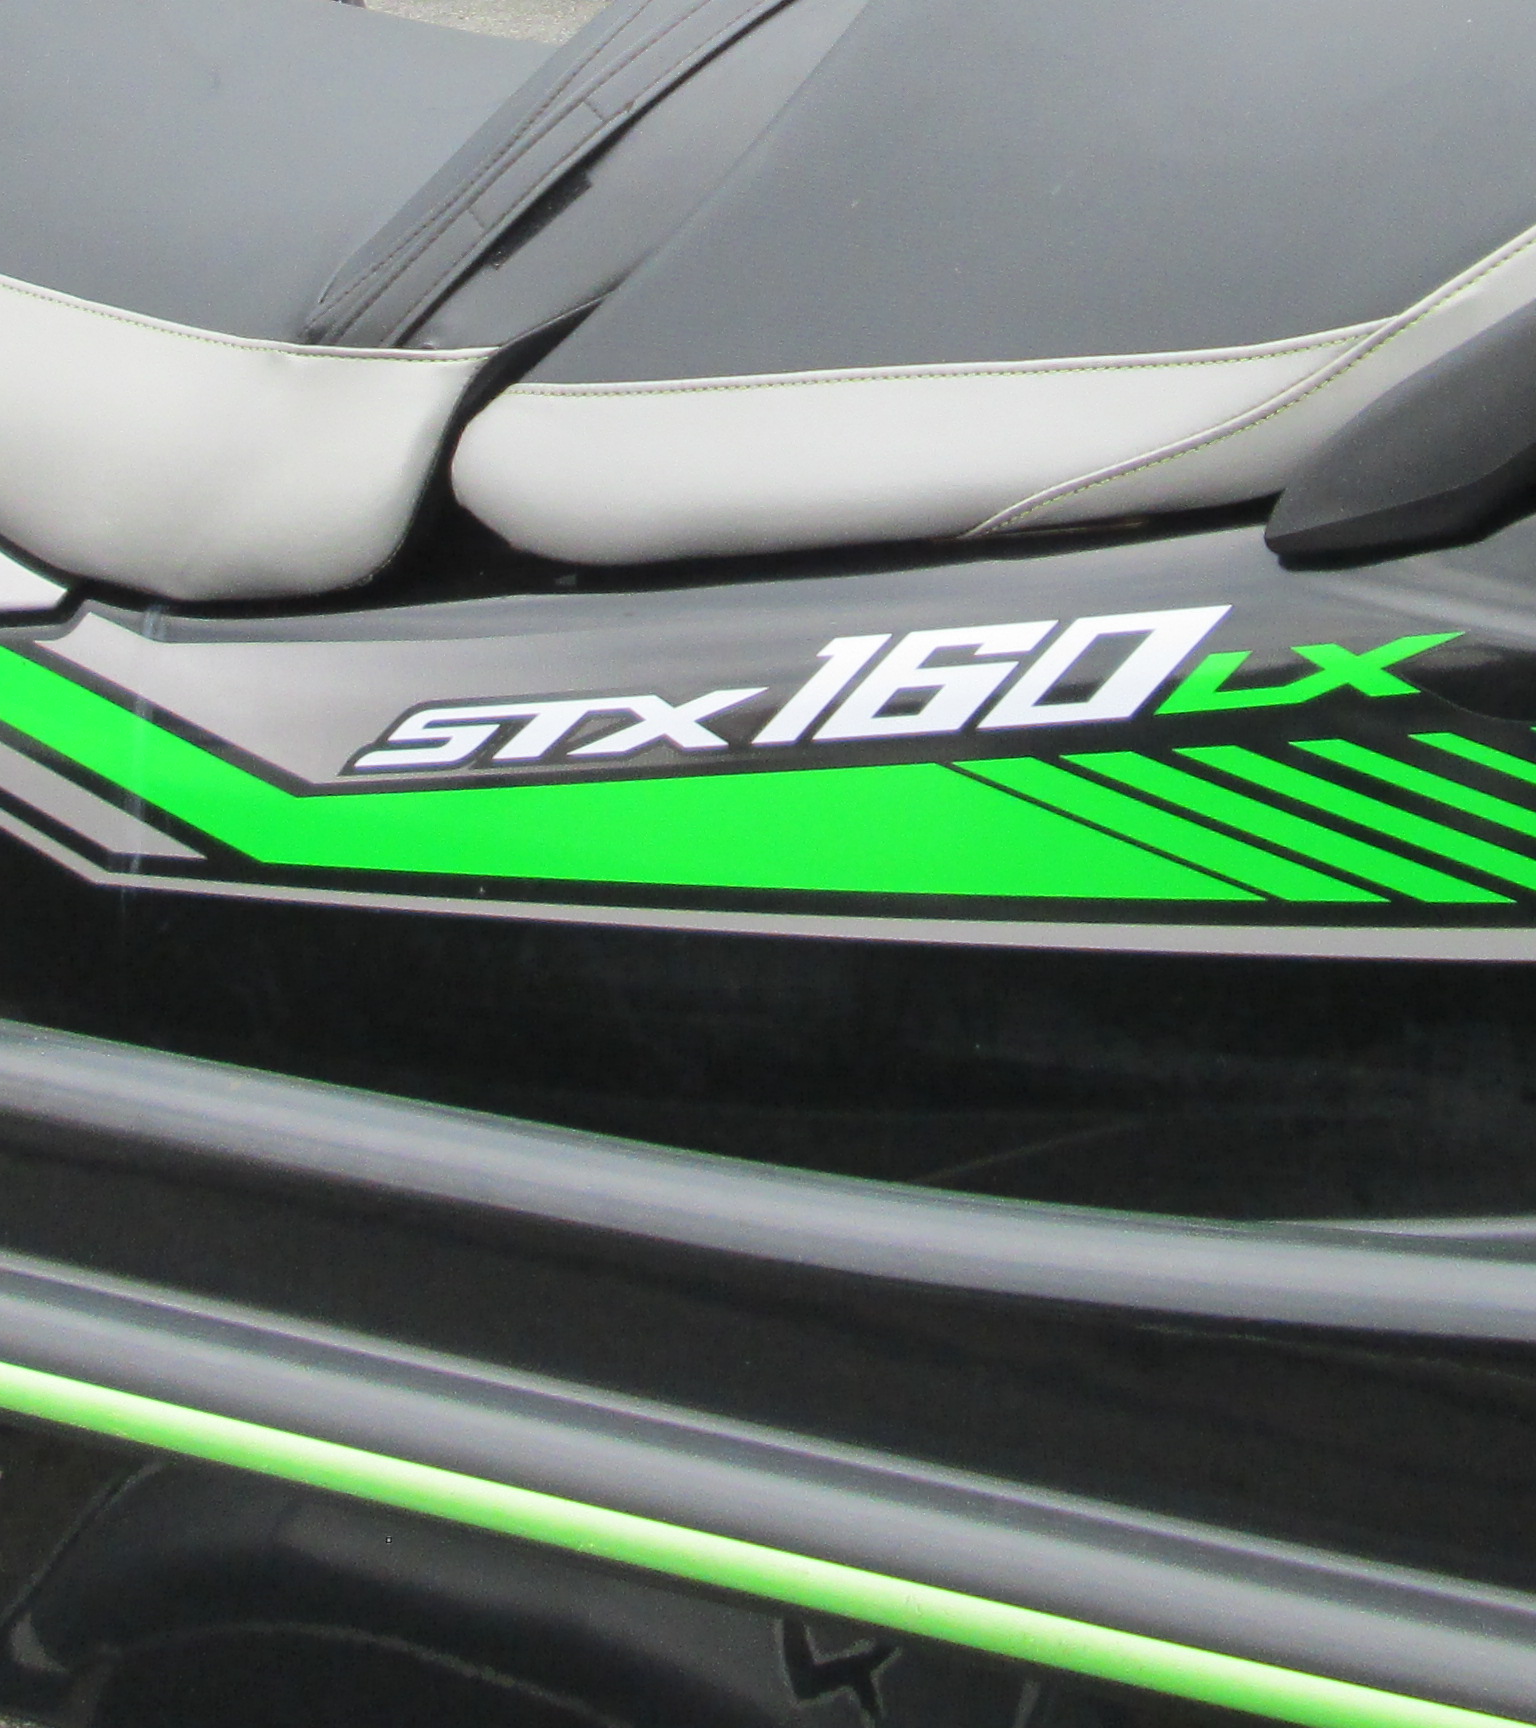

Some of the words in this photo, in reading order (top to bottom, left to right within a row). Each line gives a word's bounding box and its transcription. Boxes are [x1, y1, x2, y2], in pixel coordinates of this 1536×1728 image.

[354, 687, 769, 770] STX
[752, 604, 1232, 747] 160
[1154, 630, 1466, 715] LX
